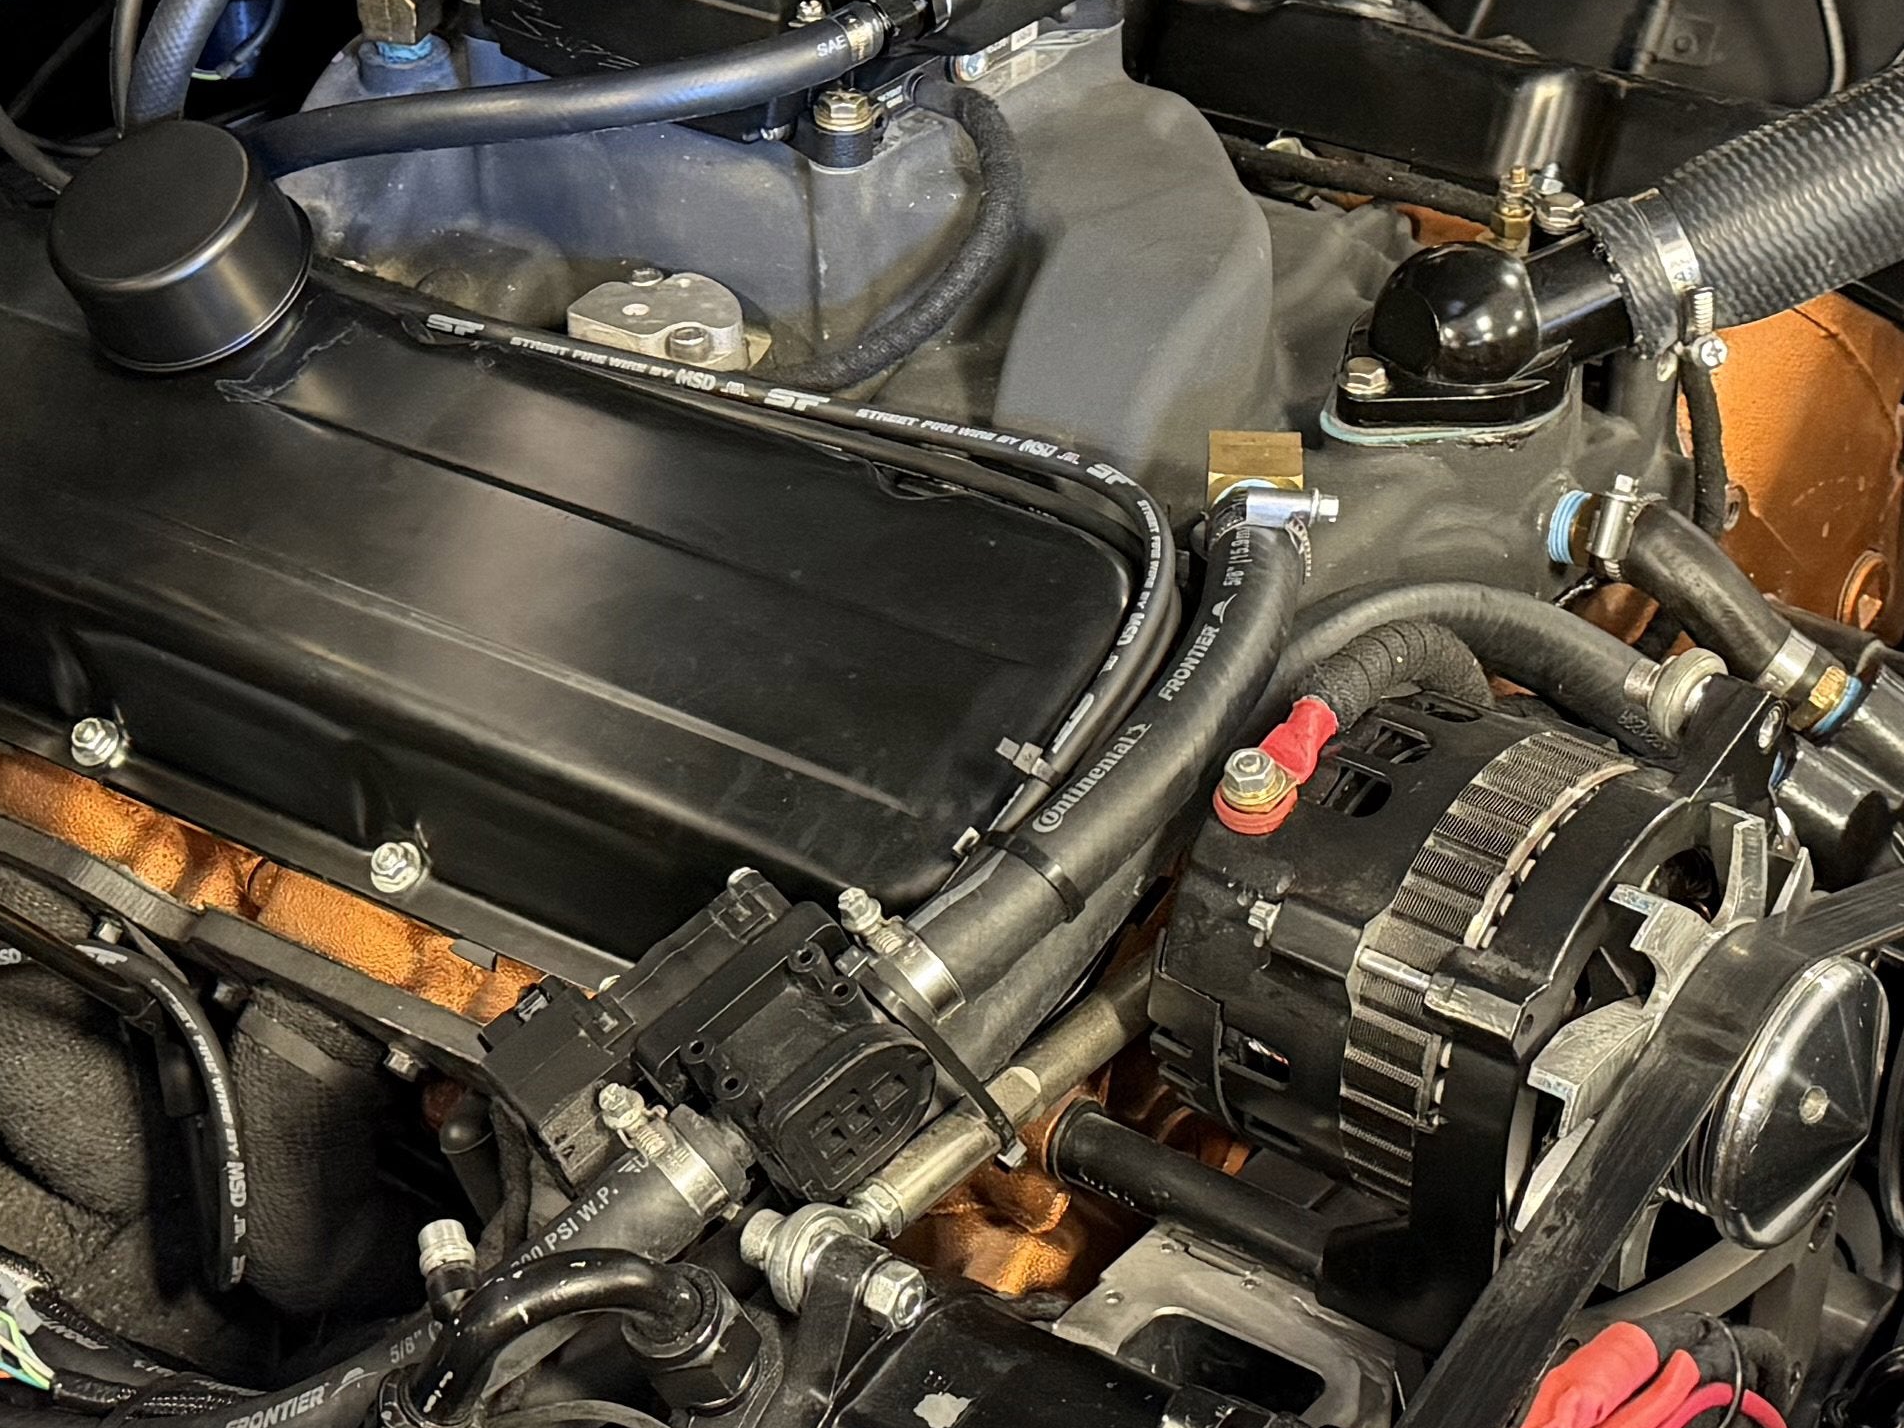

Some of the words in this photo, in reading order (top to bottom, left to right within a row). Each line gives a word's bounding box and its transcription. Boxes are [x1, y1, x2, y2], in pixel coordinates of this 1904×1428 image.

[816, 34, 846, 58] SAE
[512, 333, 568, 357] STREET
[571, 348, 605, 365] FIRE
[607, 354, 646, 374] WIRE
[648, 364, 673, 379] BY
[673, 366, 717, 392] MSD
[855, 406, 917, 428] STREET
[919, 418, 957, 434] FIRE
[957, 426, 995, 442] WIRE
[996, 433, 1020, 448] BY
[1017, 436, 1059, 460] MSD
[1025, 731, 1144, 839] Continental
[1153, 620, 1225, 703] FRONTIER
[541, 1215, 580, 1250] PSI
[572, 1180, 622, 1224] W.P.
